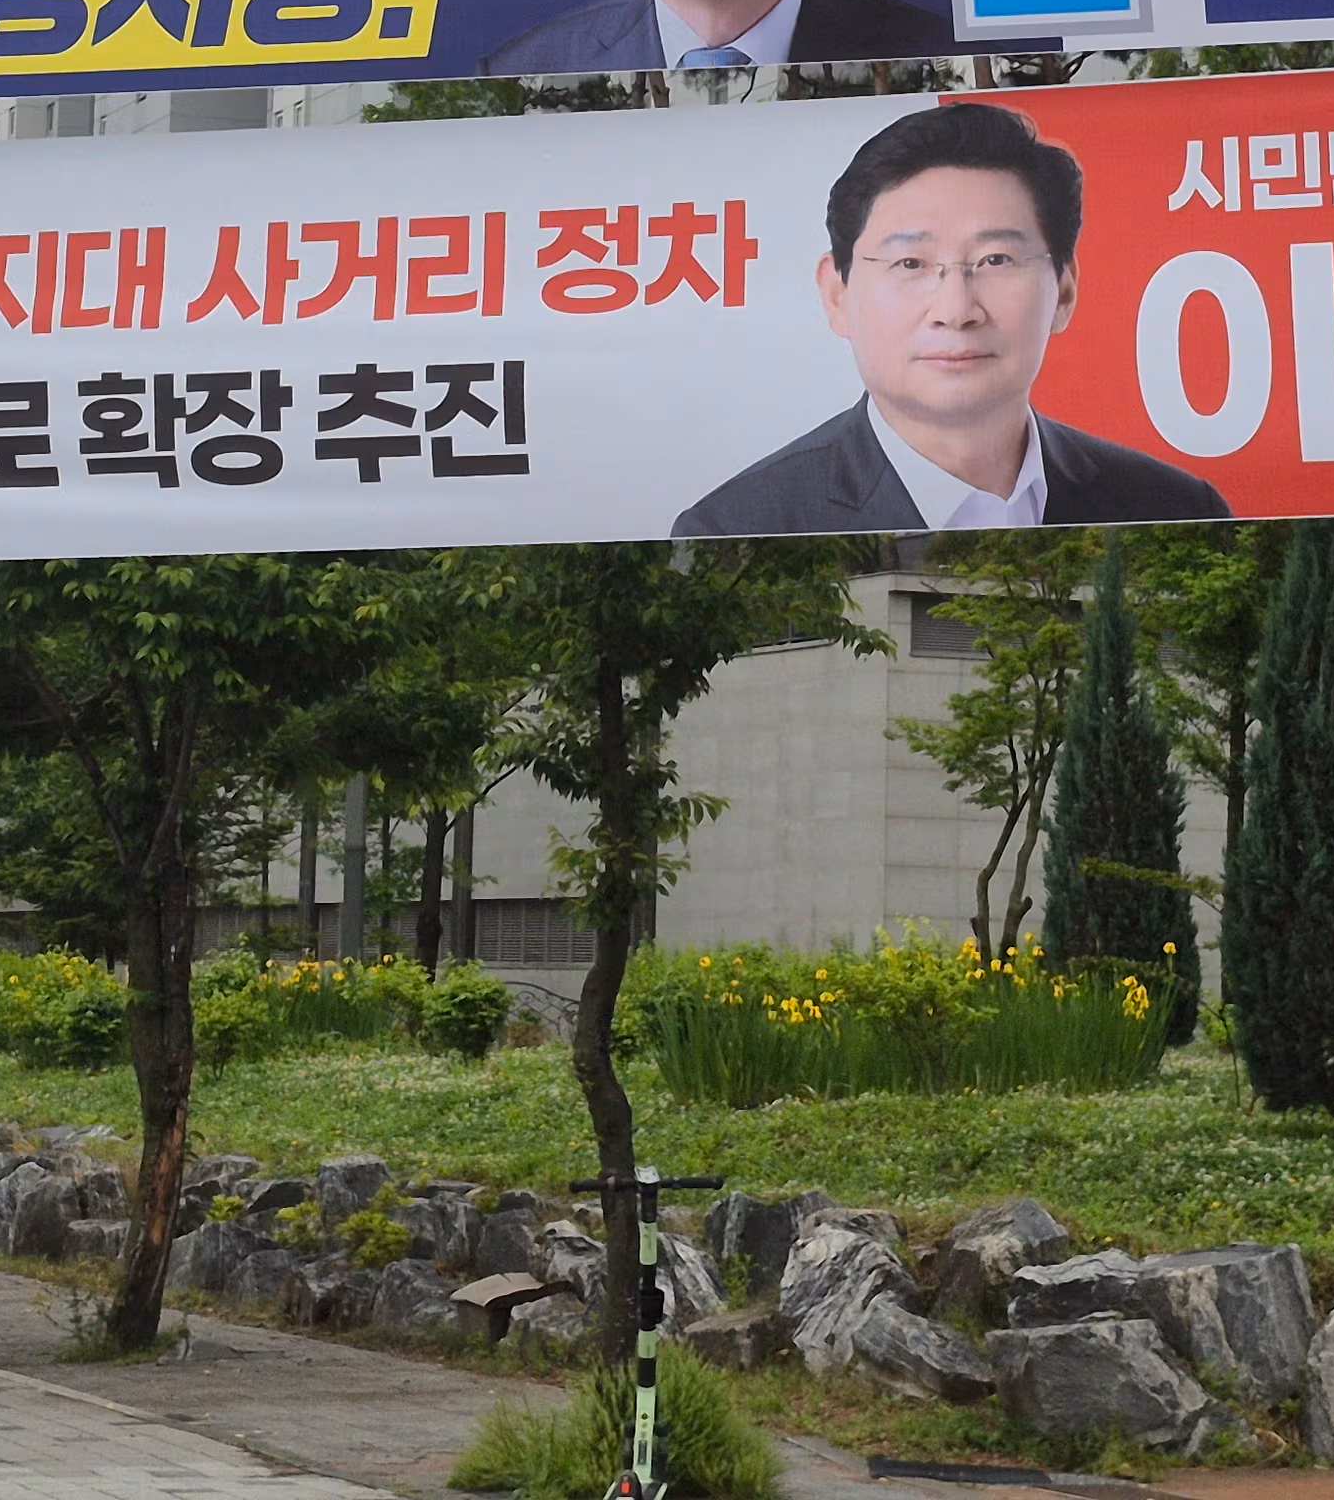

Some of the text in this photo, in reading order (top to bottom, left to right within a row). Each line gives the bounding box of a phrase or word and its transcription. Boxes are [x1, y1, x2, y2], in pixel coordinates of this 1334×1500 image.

[186, 212, 506, 325] 사거리
[537, 200, 759, 315] 정차
[77, 369, 293, 489] 확장
[315, 360, 529, 483] 추진
